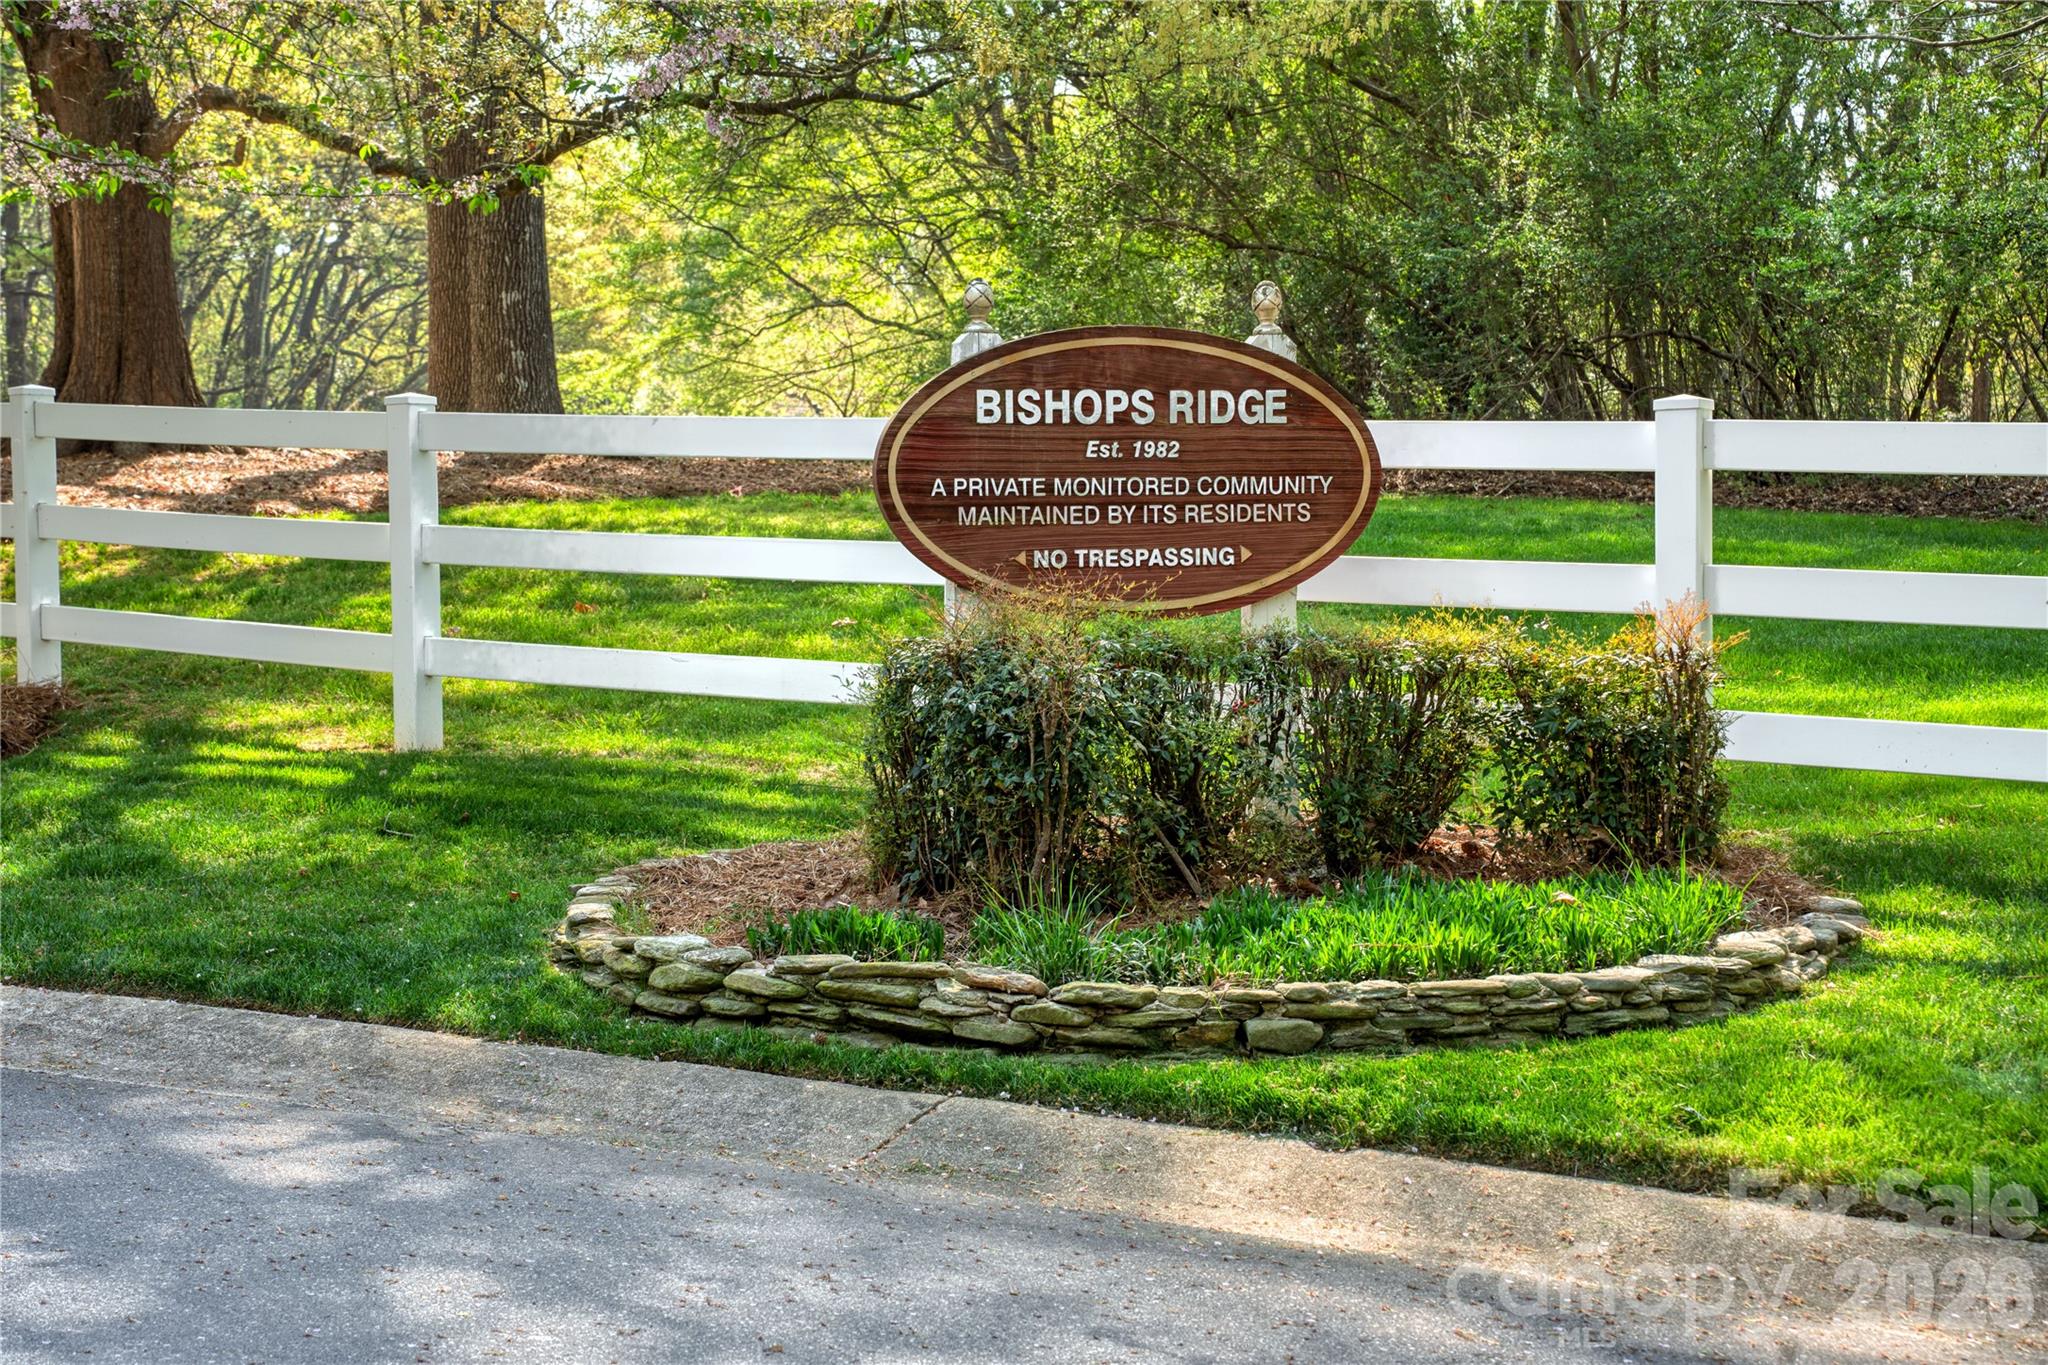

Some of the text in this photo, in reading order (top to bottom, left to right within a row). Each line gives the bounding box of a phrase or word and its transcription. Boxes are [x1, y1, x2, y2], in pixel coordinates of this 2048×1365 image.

[977, 389, 1287, 425] BISHOPS RIDGE
[1086, 441, 1179, 458] Est. 1982
[931, 476, 1332, 496] A PRIVATE MONITORED COMMUNITY
[959, 503, 1310, 525] MAINTAINED BY ITS RESIDENTS
[1034, 547, 1234, 569] NO TRESPASSING
